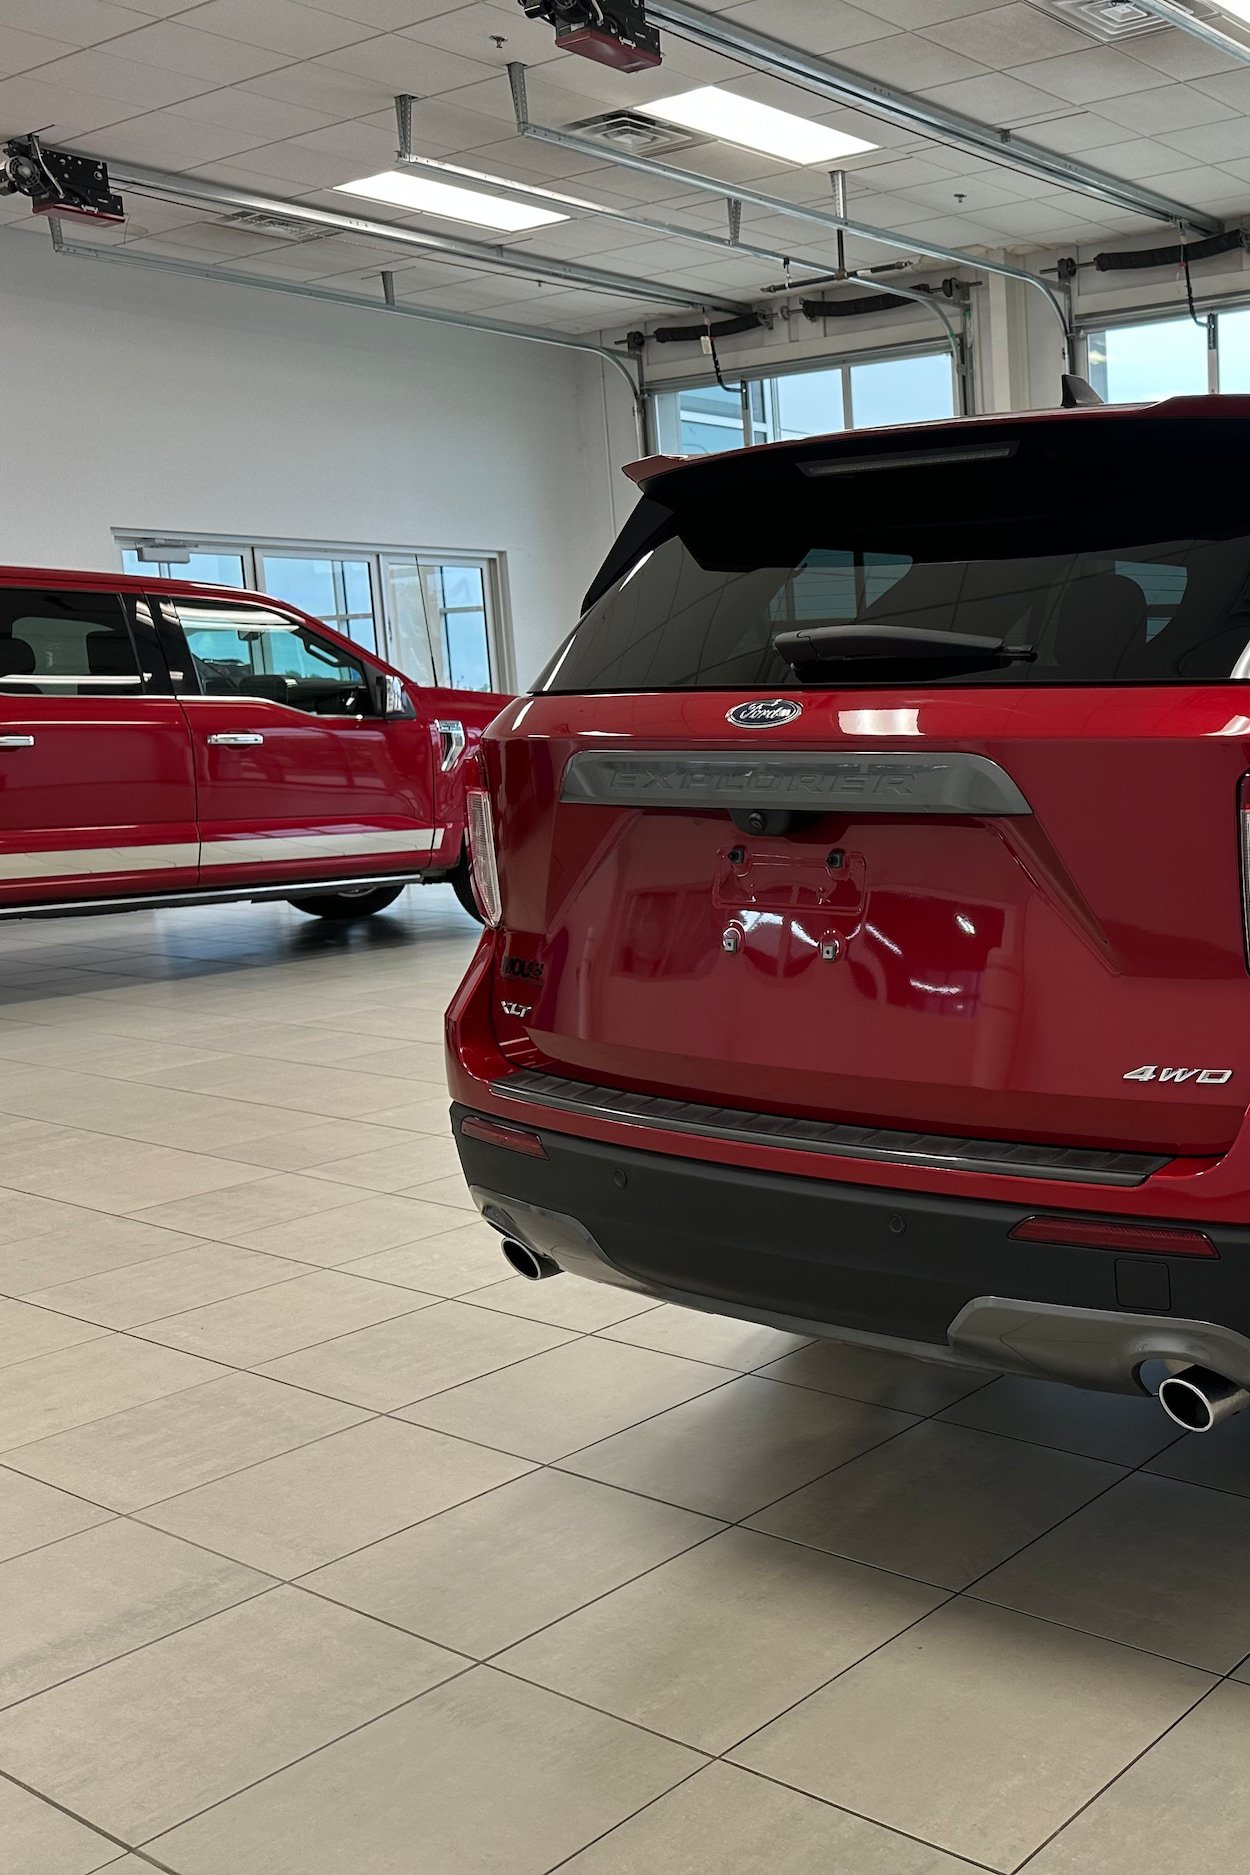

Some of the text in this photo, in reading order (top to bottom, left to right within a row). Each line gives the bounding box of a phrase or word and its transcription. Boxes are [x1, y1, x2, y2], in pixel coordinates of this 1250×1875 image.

[738, 698, 793, 720] Ford
[609, 769, 915, 796] EXPLORER
[500, 1000, 532, 1018] XLT
[1122, 1065, 1233, 1084] 4WD
